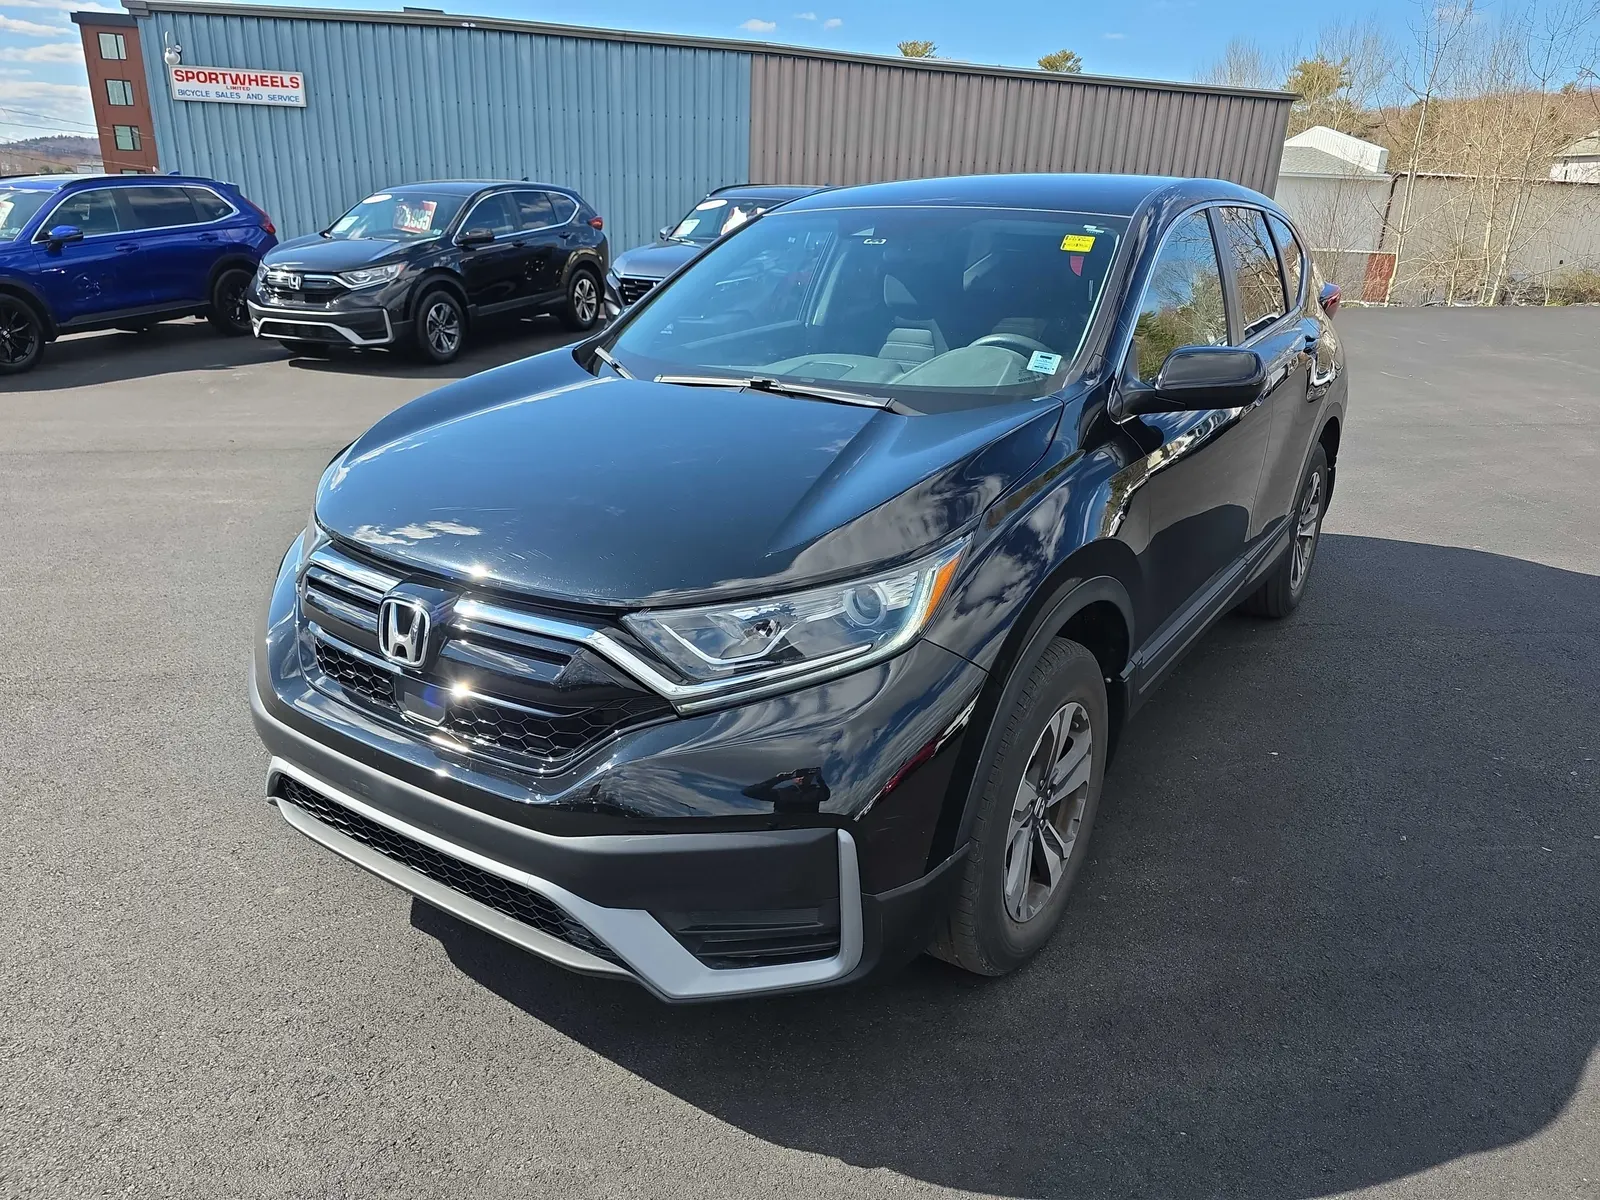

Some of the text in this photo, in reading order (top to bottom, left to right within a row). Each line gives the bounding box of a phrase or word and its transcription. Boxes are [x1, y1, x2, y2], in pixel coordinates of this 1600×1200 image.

[173, 69, 300, 89] SPORTWHEELS
[177, 89, 300, 103] BICYCLE SALES AND SERVICE
